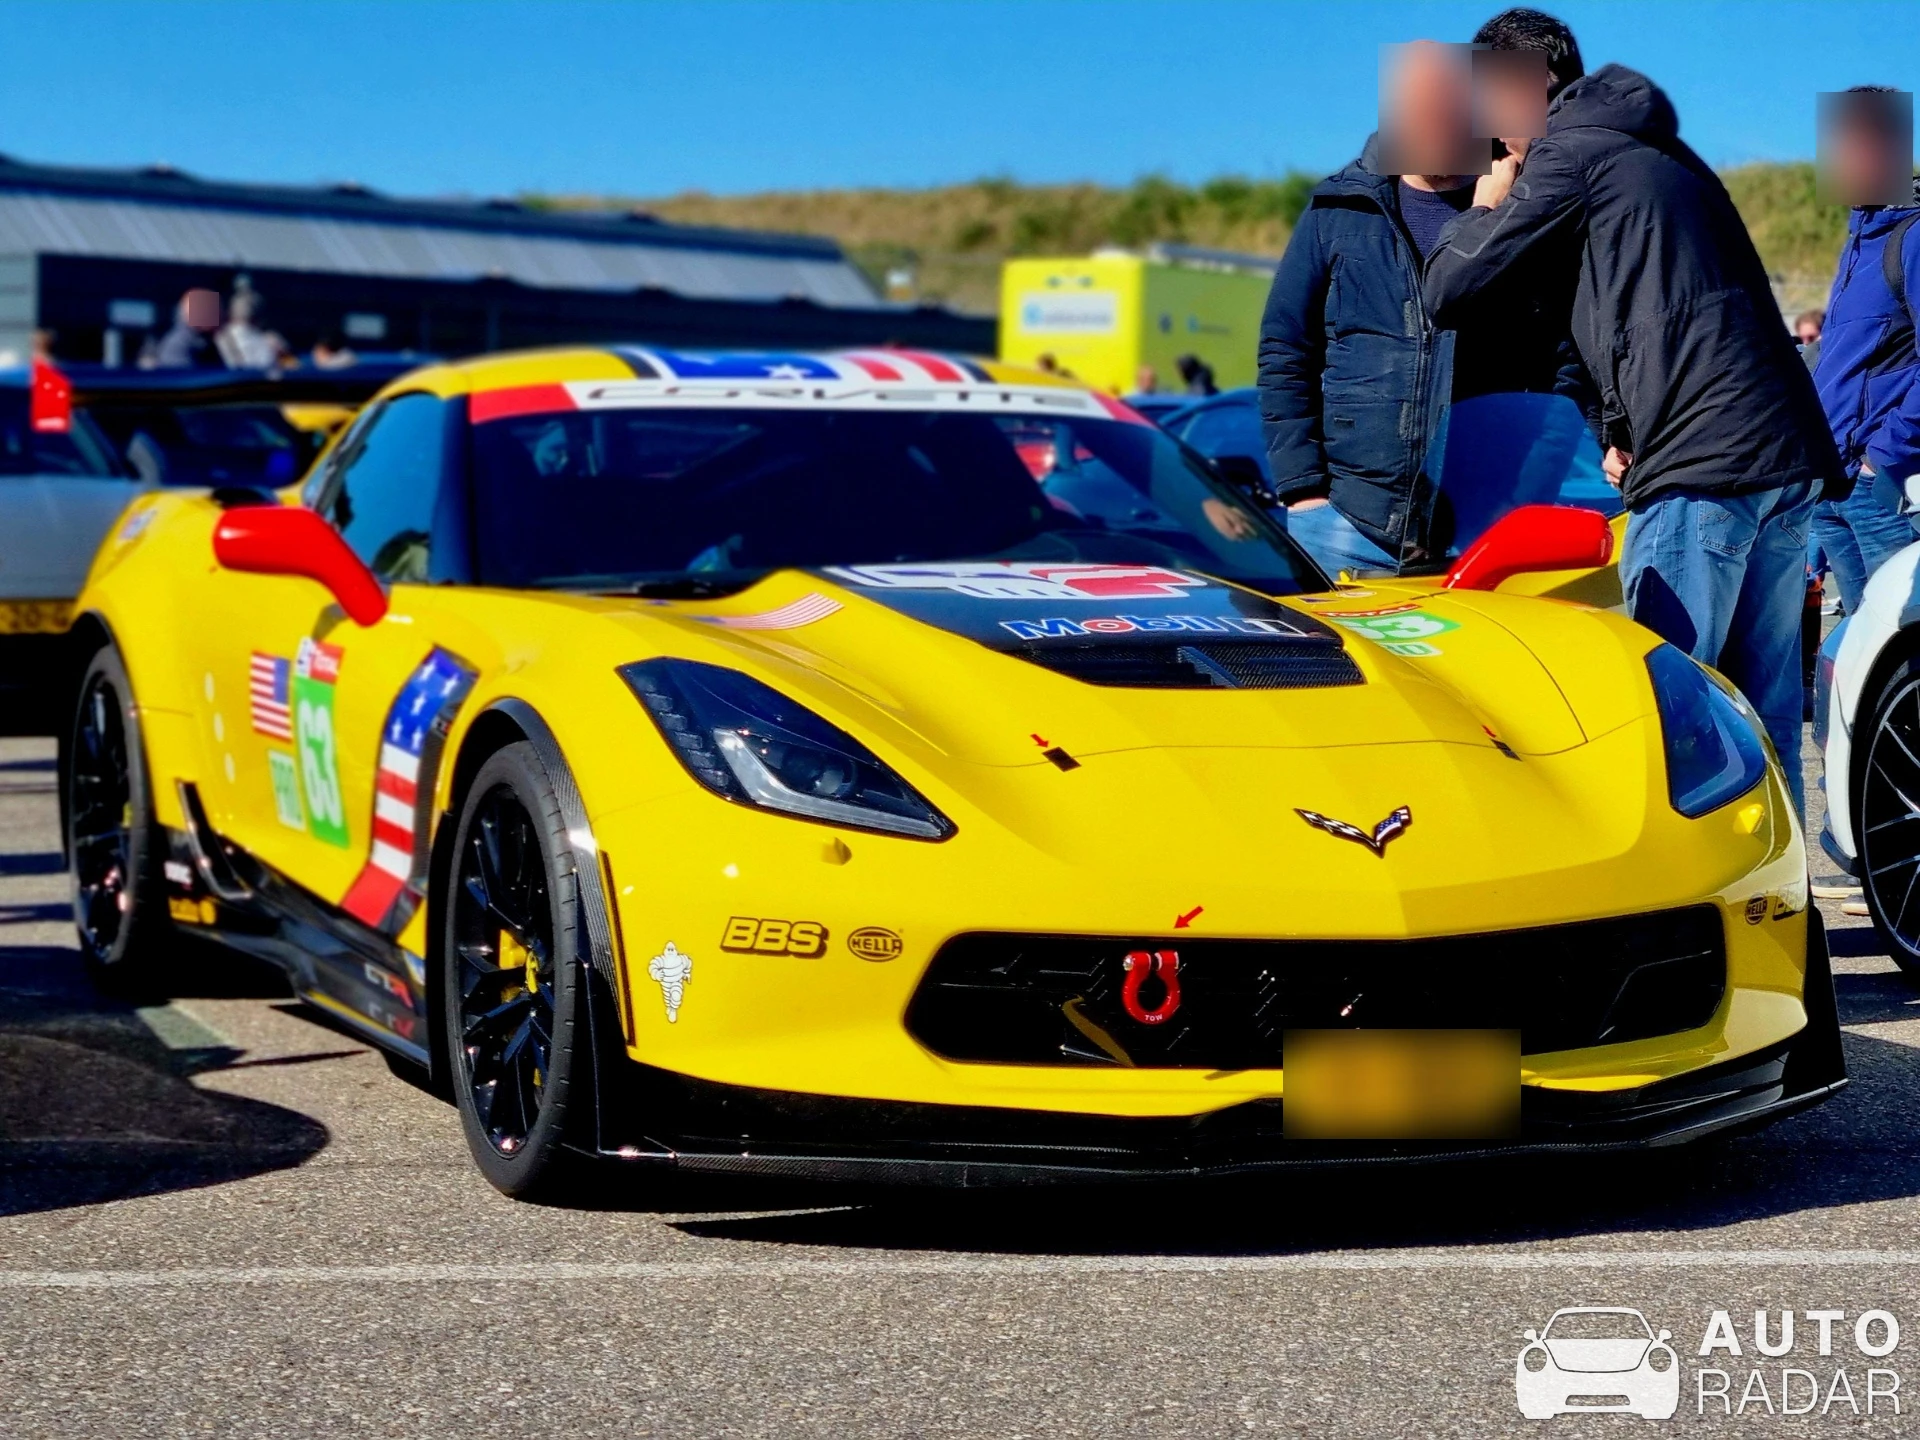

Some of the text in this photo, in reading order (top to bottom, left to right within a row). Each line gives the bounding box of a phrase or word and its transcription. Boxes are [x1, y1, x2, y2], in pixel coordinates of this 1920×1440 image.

[586, 385, 1088, 409] CORVETTE
[299, 697, 344, 829] 63
[720, 916, 829, 959] BBS
[848, 934, 904, 956] HELLA
[1144, 1013, 1163, 1022] TOW
